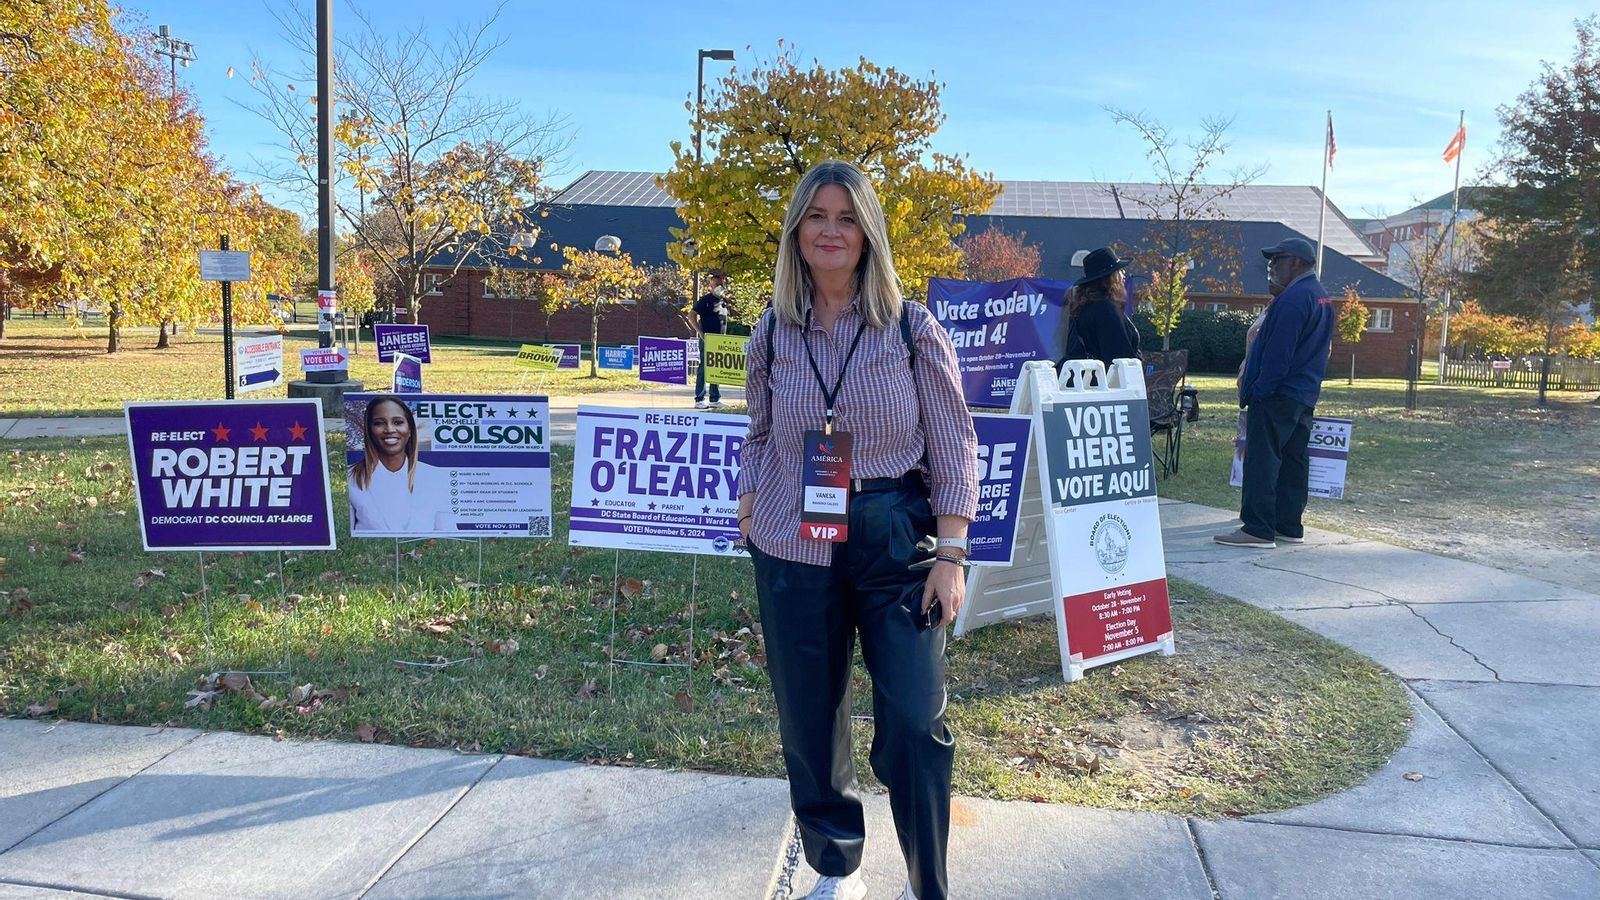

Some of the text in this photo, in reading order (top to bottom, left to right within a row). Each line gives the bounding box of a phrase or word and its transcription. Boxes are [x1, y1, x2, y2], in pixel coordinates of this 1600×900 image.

[936, 291, 1048, 321] Vote today,
[380, 332, 426, 346] JANEESE
[990, 322, 1008, 345] 4!
[519, 352, 560, 363] BROWN
[604, 350, 627, 358] HARRIS
[642, 349, 684, 362] JANEESE
[706, 351, 745, 370] BROW
[991, 379, 1017, 388] JANEE
[417, 403, 487, 419] ELECT
[645, 413, 699, 427] RE-ELECT
[1064, 404, 1131, 437] VOTE
[151, 431, 205, 442] RE-ELECT
[434, 425, 543, 444] COLSON
[1309, 434, 1346, 447] SON
[592, 426, 746, 467] FRAZIER
[1066, 435, 1136, 470] HERE
[151, 446, 311, 477] ROBERT
[811, 455, 843, 463] AMÉRICA
[976, 442, 1017, 481] SE
[1057, 462, 1150, 500] VOTE AQUÍ
[162, 477, 292, 508] WHITE
[979, 483, 1011, 499] RGE
[612, 511, 631, 519] State
[632, 512, 652, 520] Board
[661, 514, 696, 523] Education
[976, 499, 1008, 520] ard 4
[151, 514, 313, 525] DEMOCRAT DC COUNCIL AT-LARGE
[1100, 514, 1107, 522] OF
[1107, 513, 1132, 540] ELECTIONS
[623, 525, 644, 533] VOTE!
[644, 525, 678, 536] November
[679, 529, 687, 537] 5,
[810, 526, 838, 540] VIP
[1104, 591, 1116, 600] Early
[1092, 603, 1110, 612] October
[1120, 596, 1142, 606] November
[1099, 611, 1110, 620] 8:30
[1121, 607, 1132, 615] 7:00
[1106, 619, 1136, 631] Election Day
[1104, 625, 1139, 641] November 5
[1103, 643, 1114, 652] 7:00
[1125, 638, 1136, 647] 8:00
